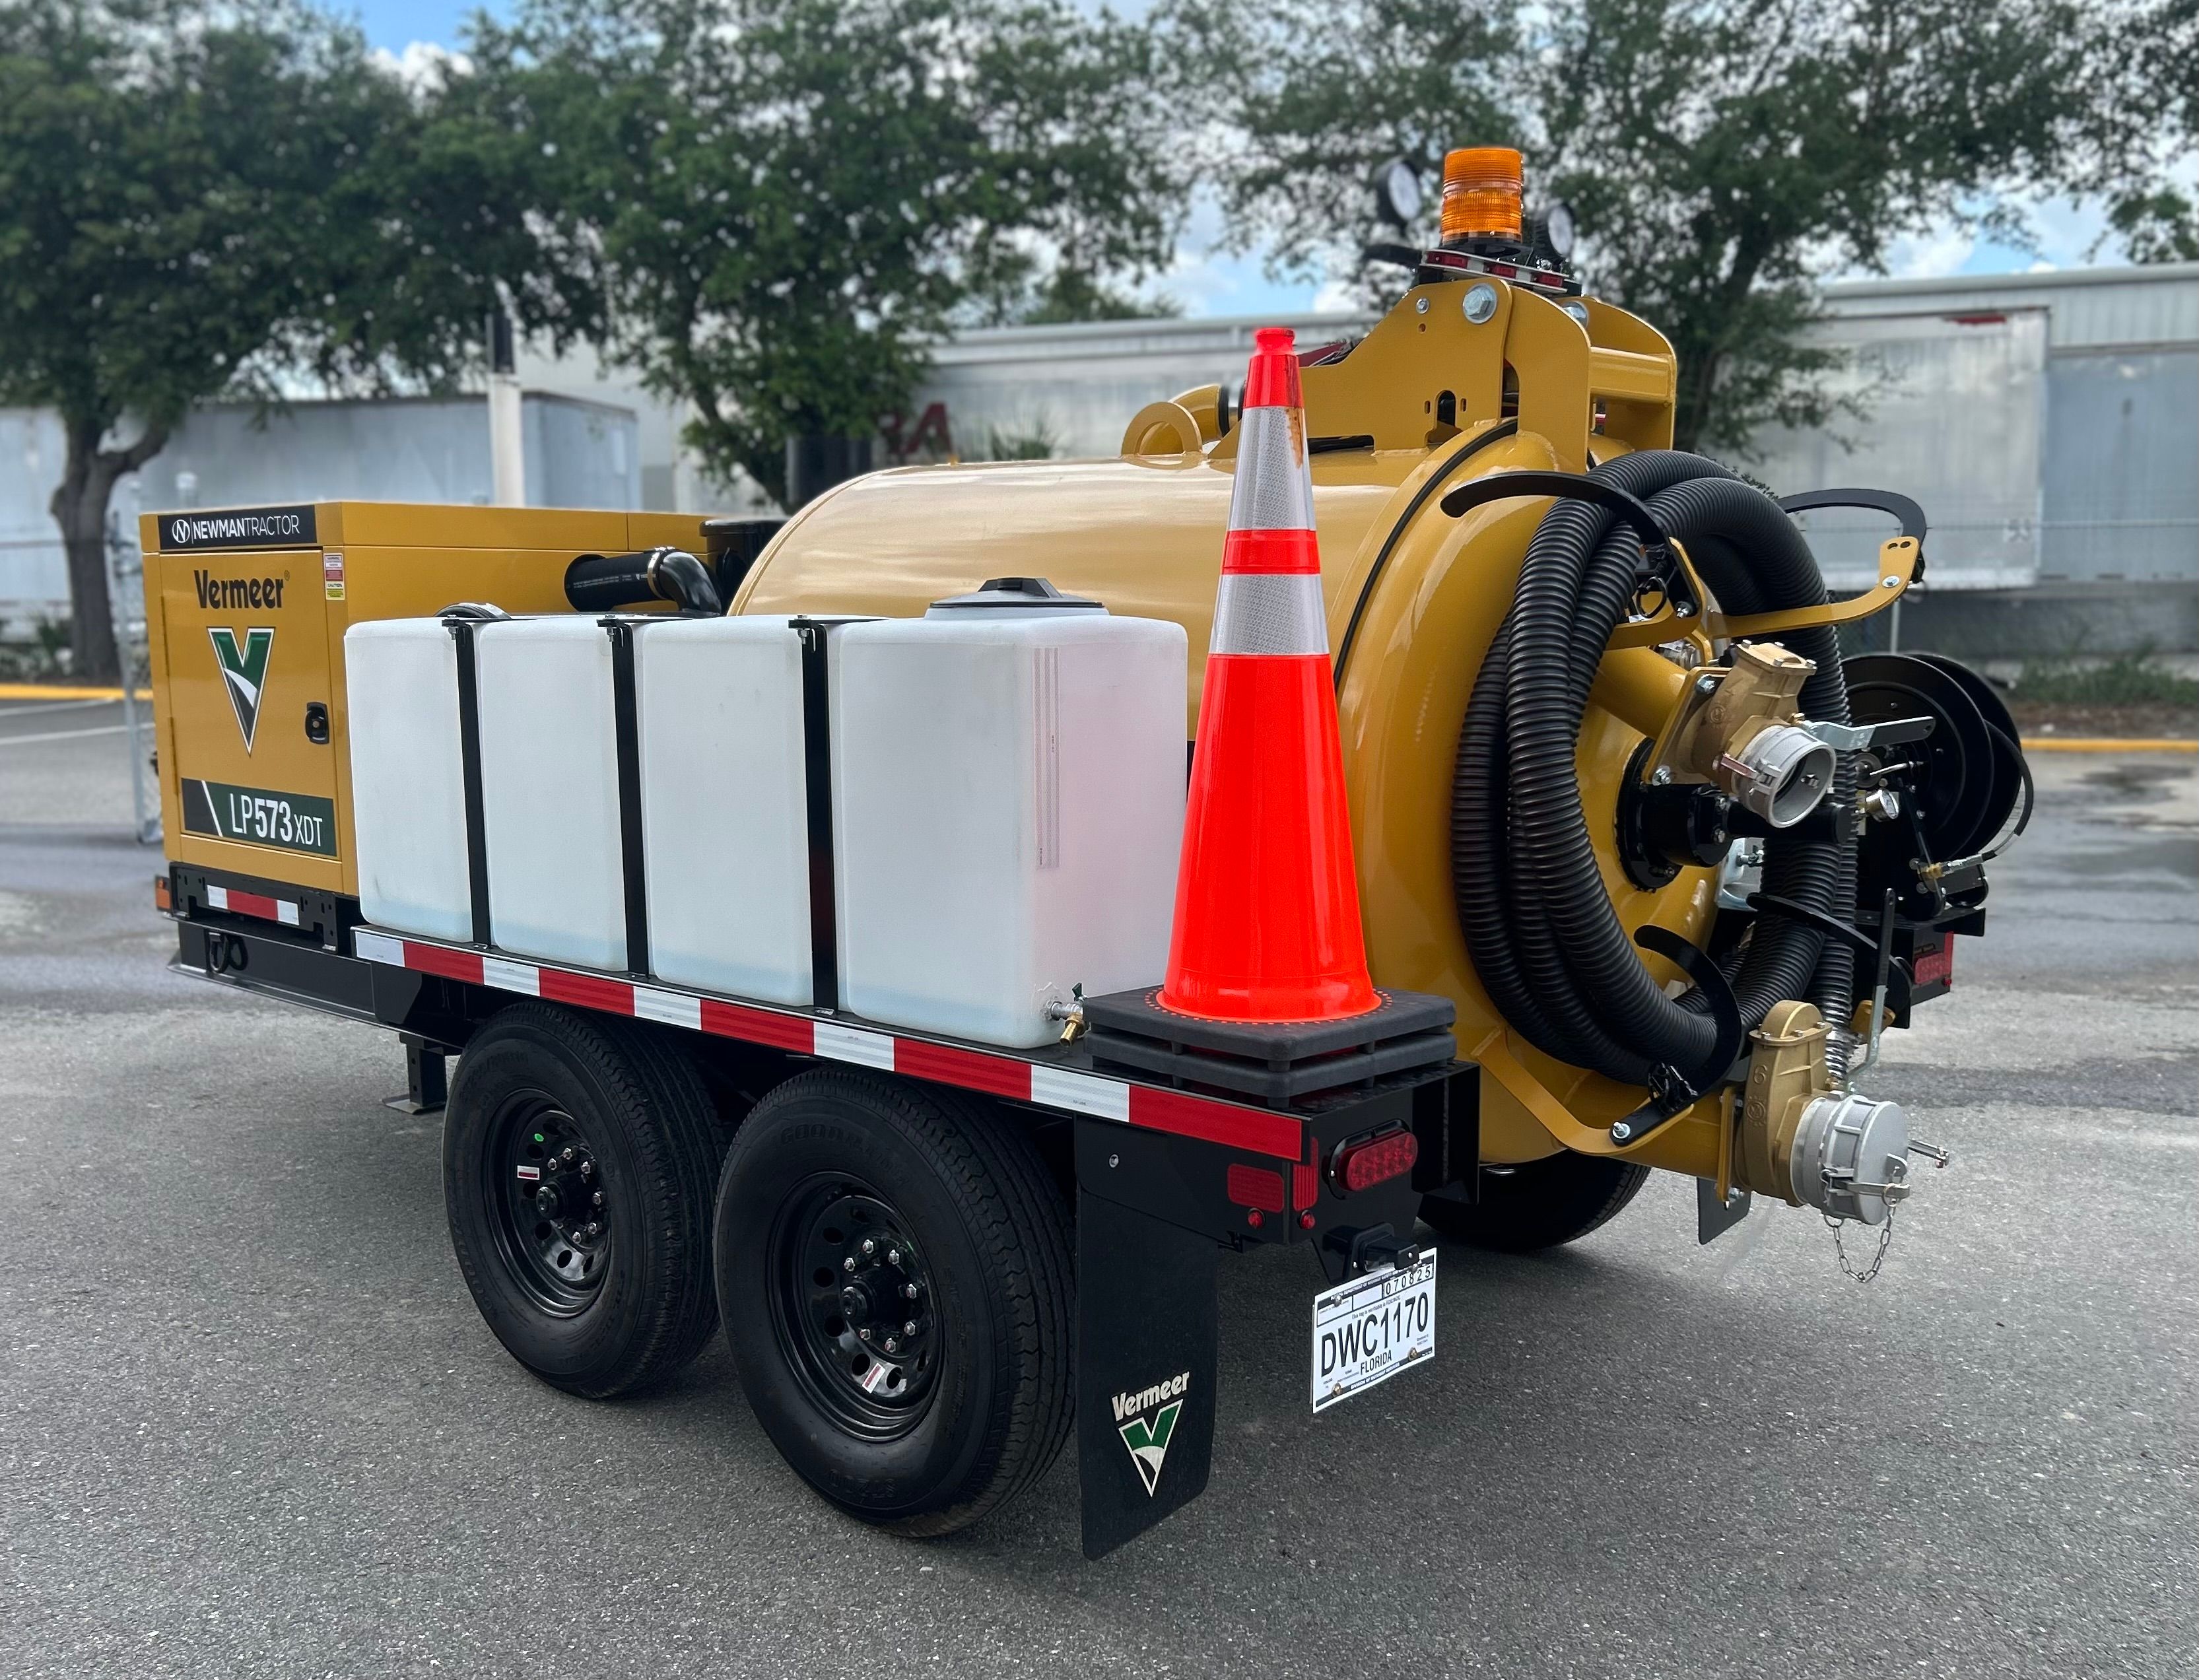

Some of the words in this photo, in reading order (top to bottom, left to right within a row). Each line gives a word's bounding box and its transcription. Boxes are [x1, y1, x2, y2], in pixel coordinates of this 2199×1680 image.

[193, 570, 285, 609] Vermeer
[1754, 1064, 1767, 1085] 6
[1386, 1265, 1431, 1295] 070825
[1321, 1292, 1429, 1377] DWC1170
[1361, 1349, 1392, 1375] FLORIDA
[1112, 1371, 1190, 1421] Vermeer
